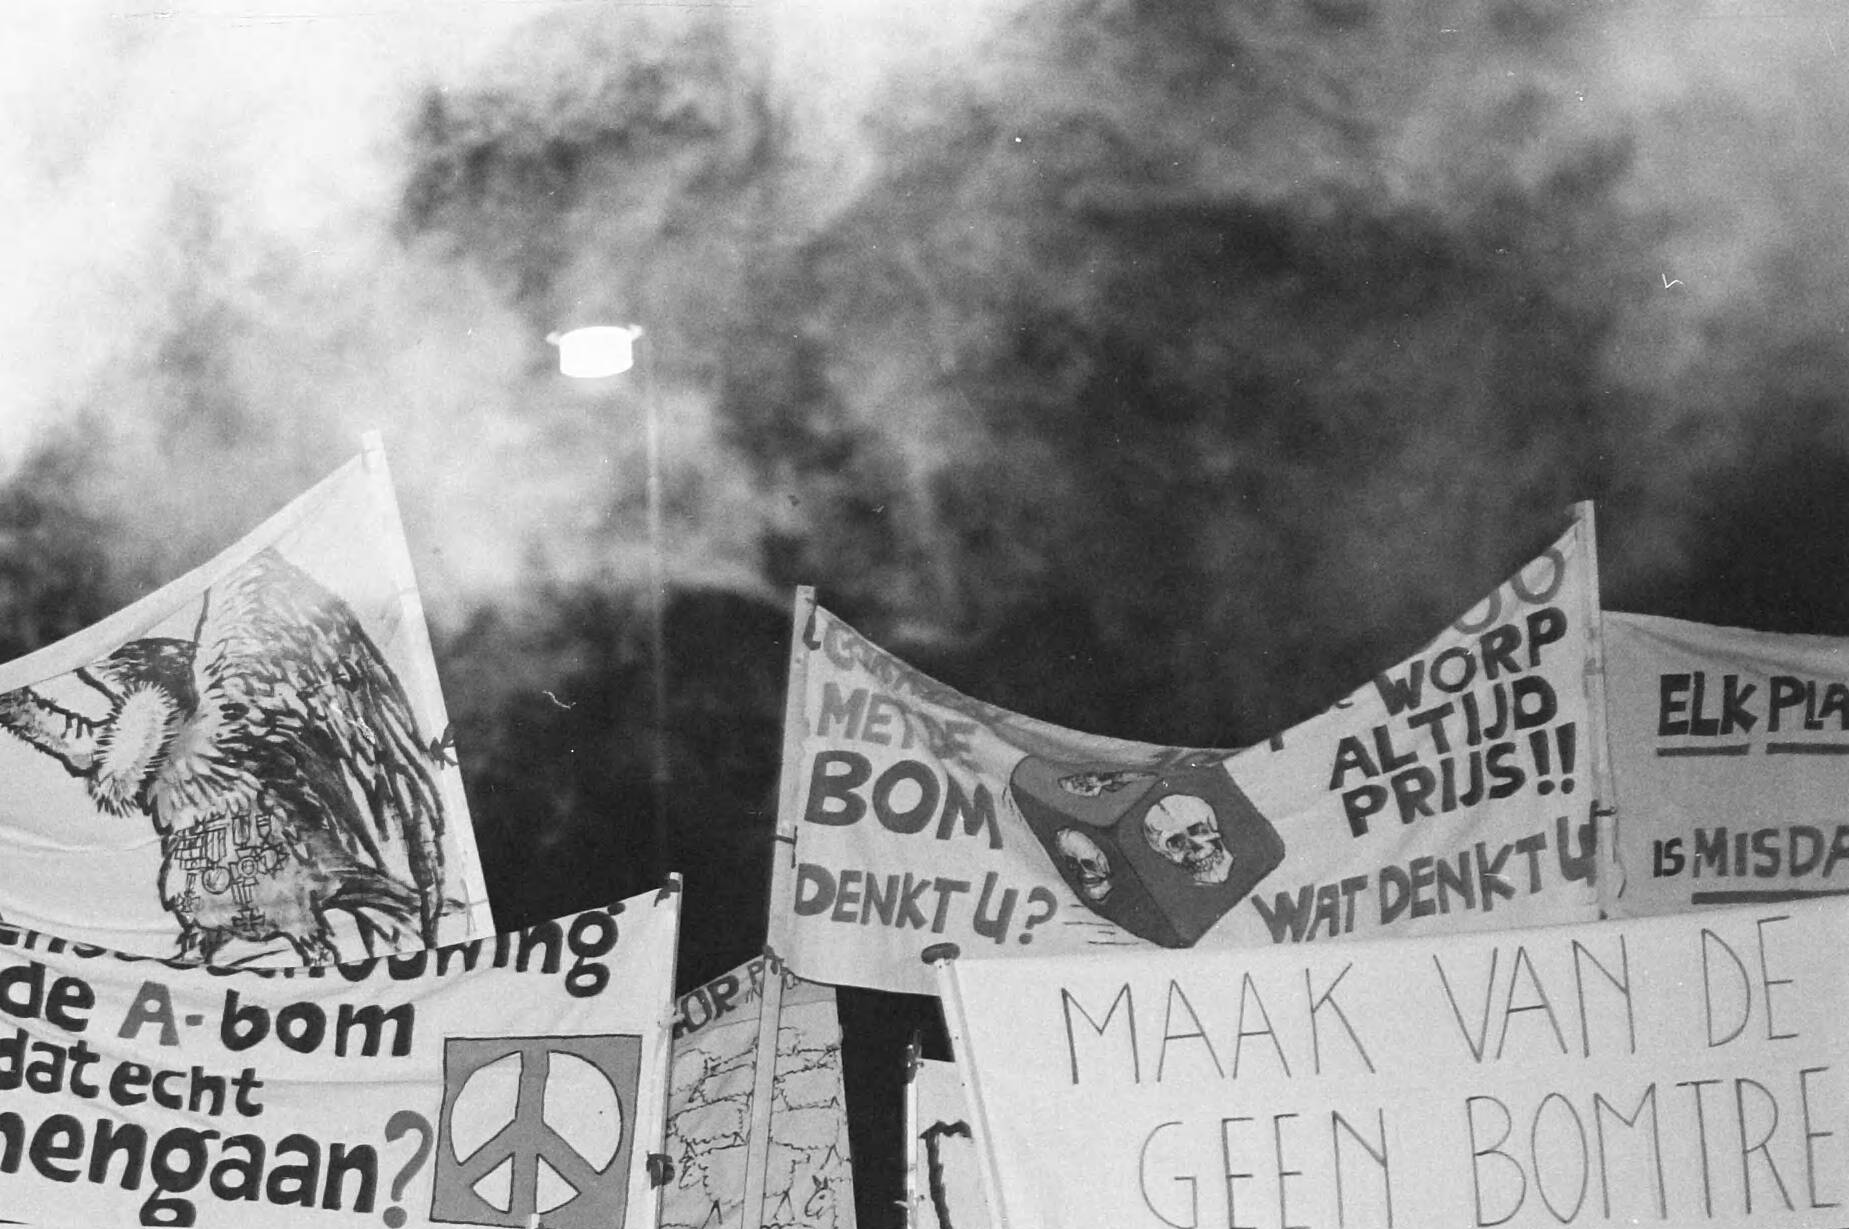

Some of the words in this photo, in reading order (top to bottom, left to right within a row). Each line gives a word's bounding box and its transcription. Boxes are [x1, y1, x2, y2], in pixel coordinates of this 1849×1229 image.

[1372, 606, 1568, 716] WORP
[1657, 671, 1758, 737] ELK
[1330, 675, 1559, 791] ALTIJD
[1342, 722, 1577, 838] PRIJS!!
[804, 749, 1004, 850] BOM
[793, 862, 971, 934] DENKT
[972, 871, 1058, 945] U?
[1250, 874, 1368, 944] WAT
[1378, 832, 1548, 925] DENKT
[1653, 837, 1686, 878] IS
[117, 981, 415, 1058] A-bom
[1060, 962, 1376, 1086] MAAK
[1433, 933, 1636, 1065] VAN
[1700, 915, 1800, 1047] DE
[109, 1060, 264, 1117] echt
[1464, 1065, 1842, 1228] BOMTRE
